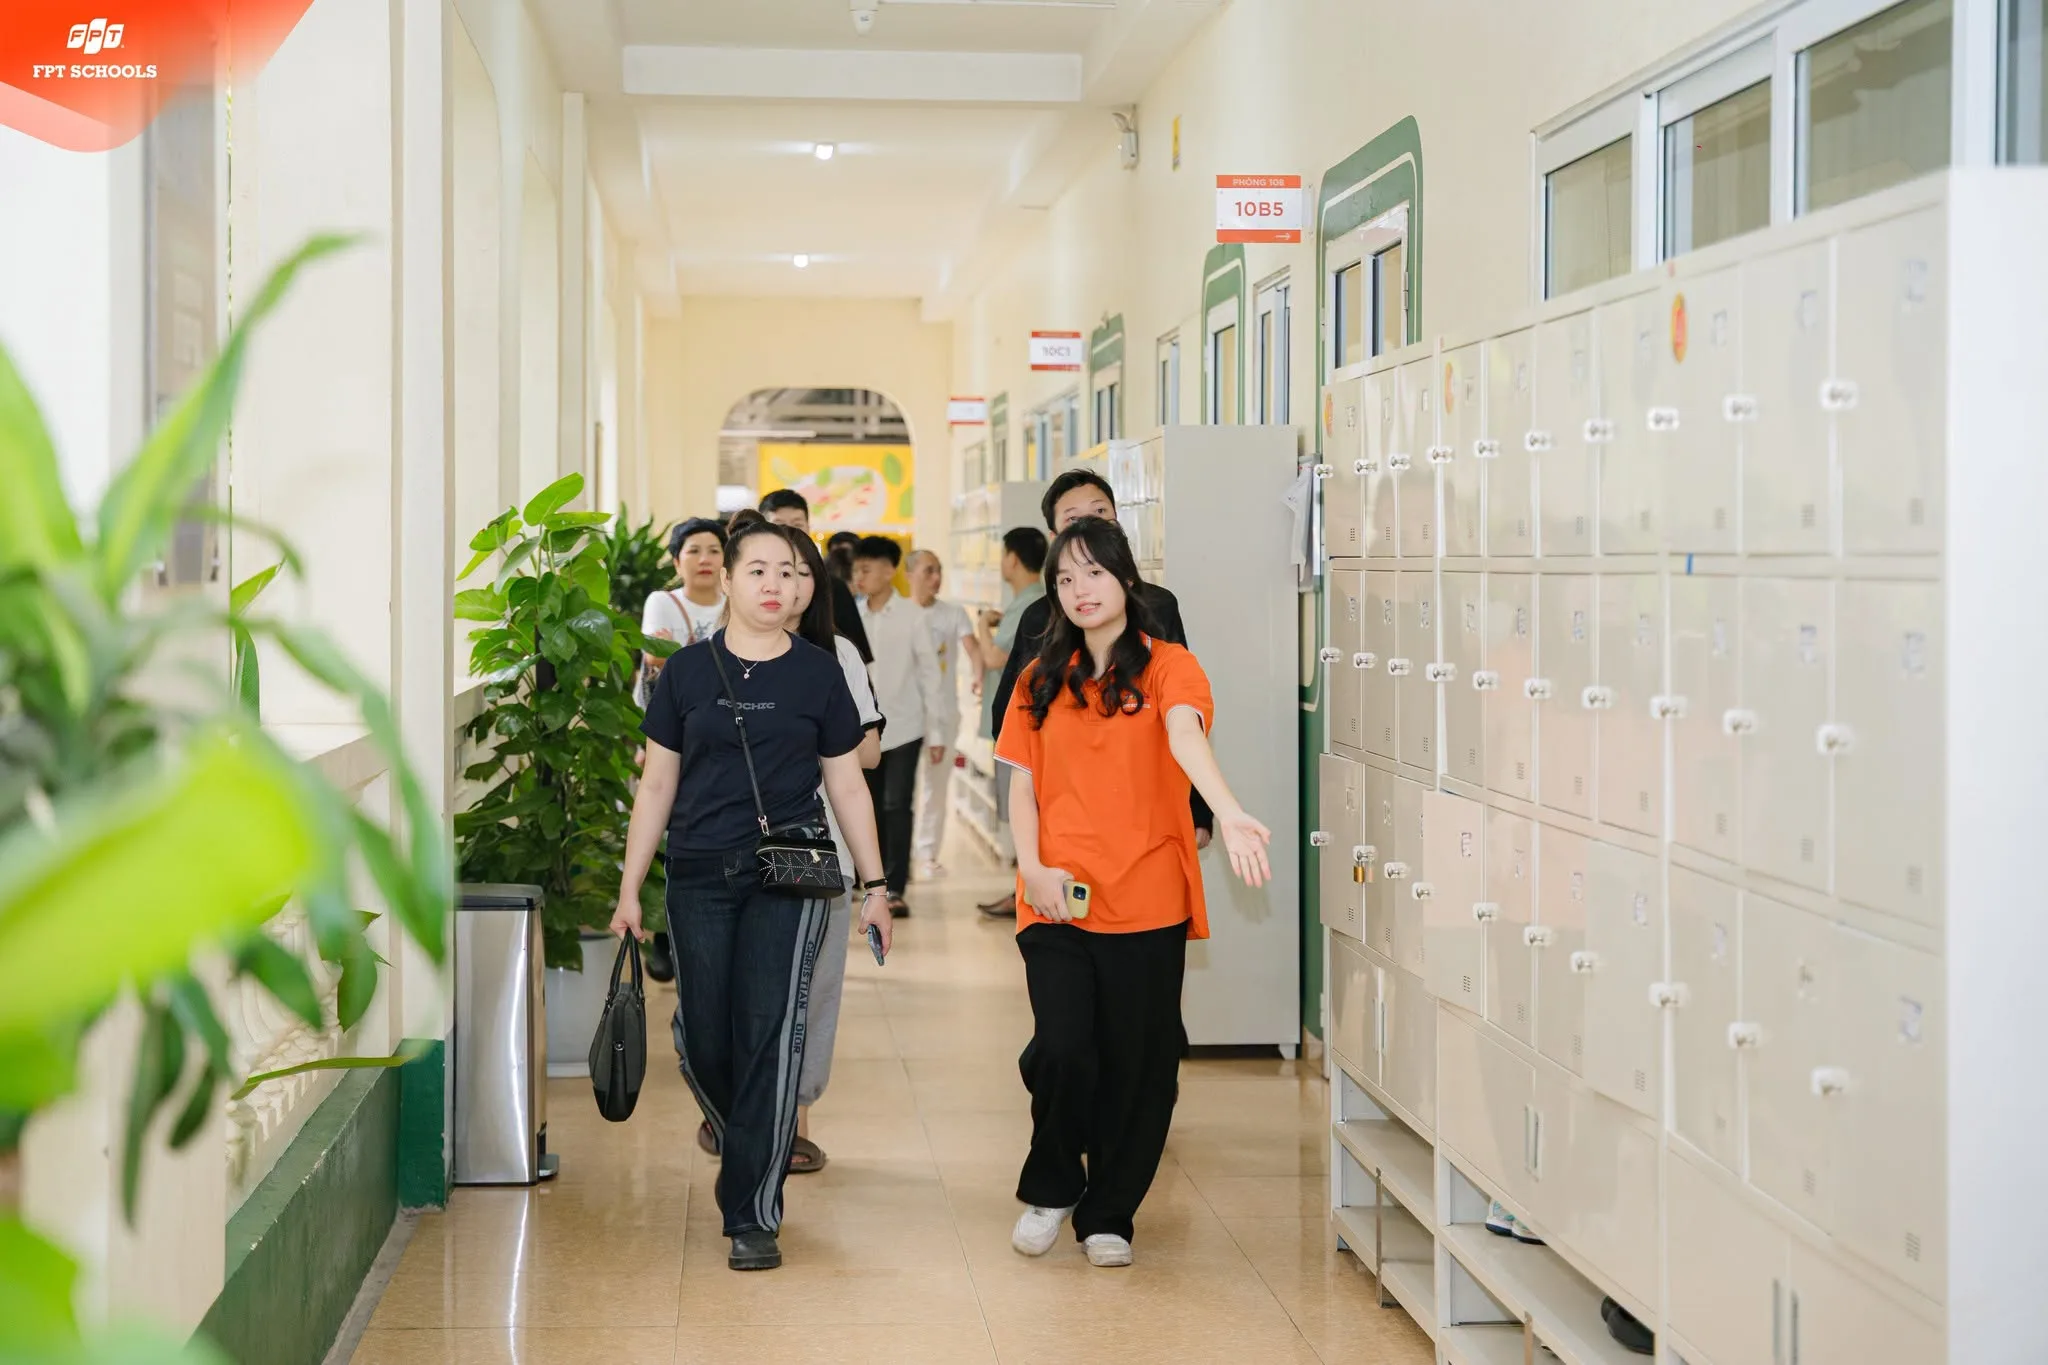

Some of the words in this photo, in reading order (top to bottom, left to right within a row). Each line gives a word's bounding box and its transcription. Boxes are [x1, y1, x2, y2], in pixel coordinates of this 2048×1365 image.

[1235, 201, 1284, 217] 10B5
[798, 940, 815, 1010] CHRISTIAN
[793, 1023, 804, 1054] DIOR
